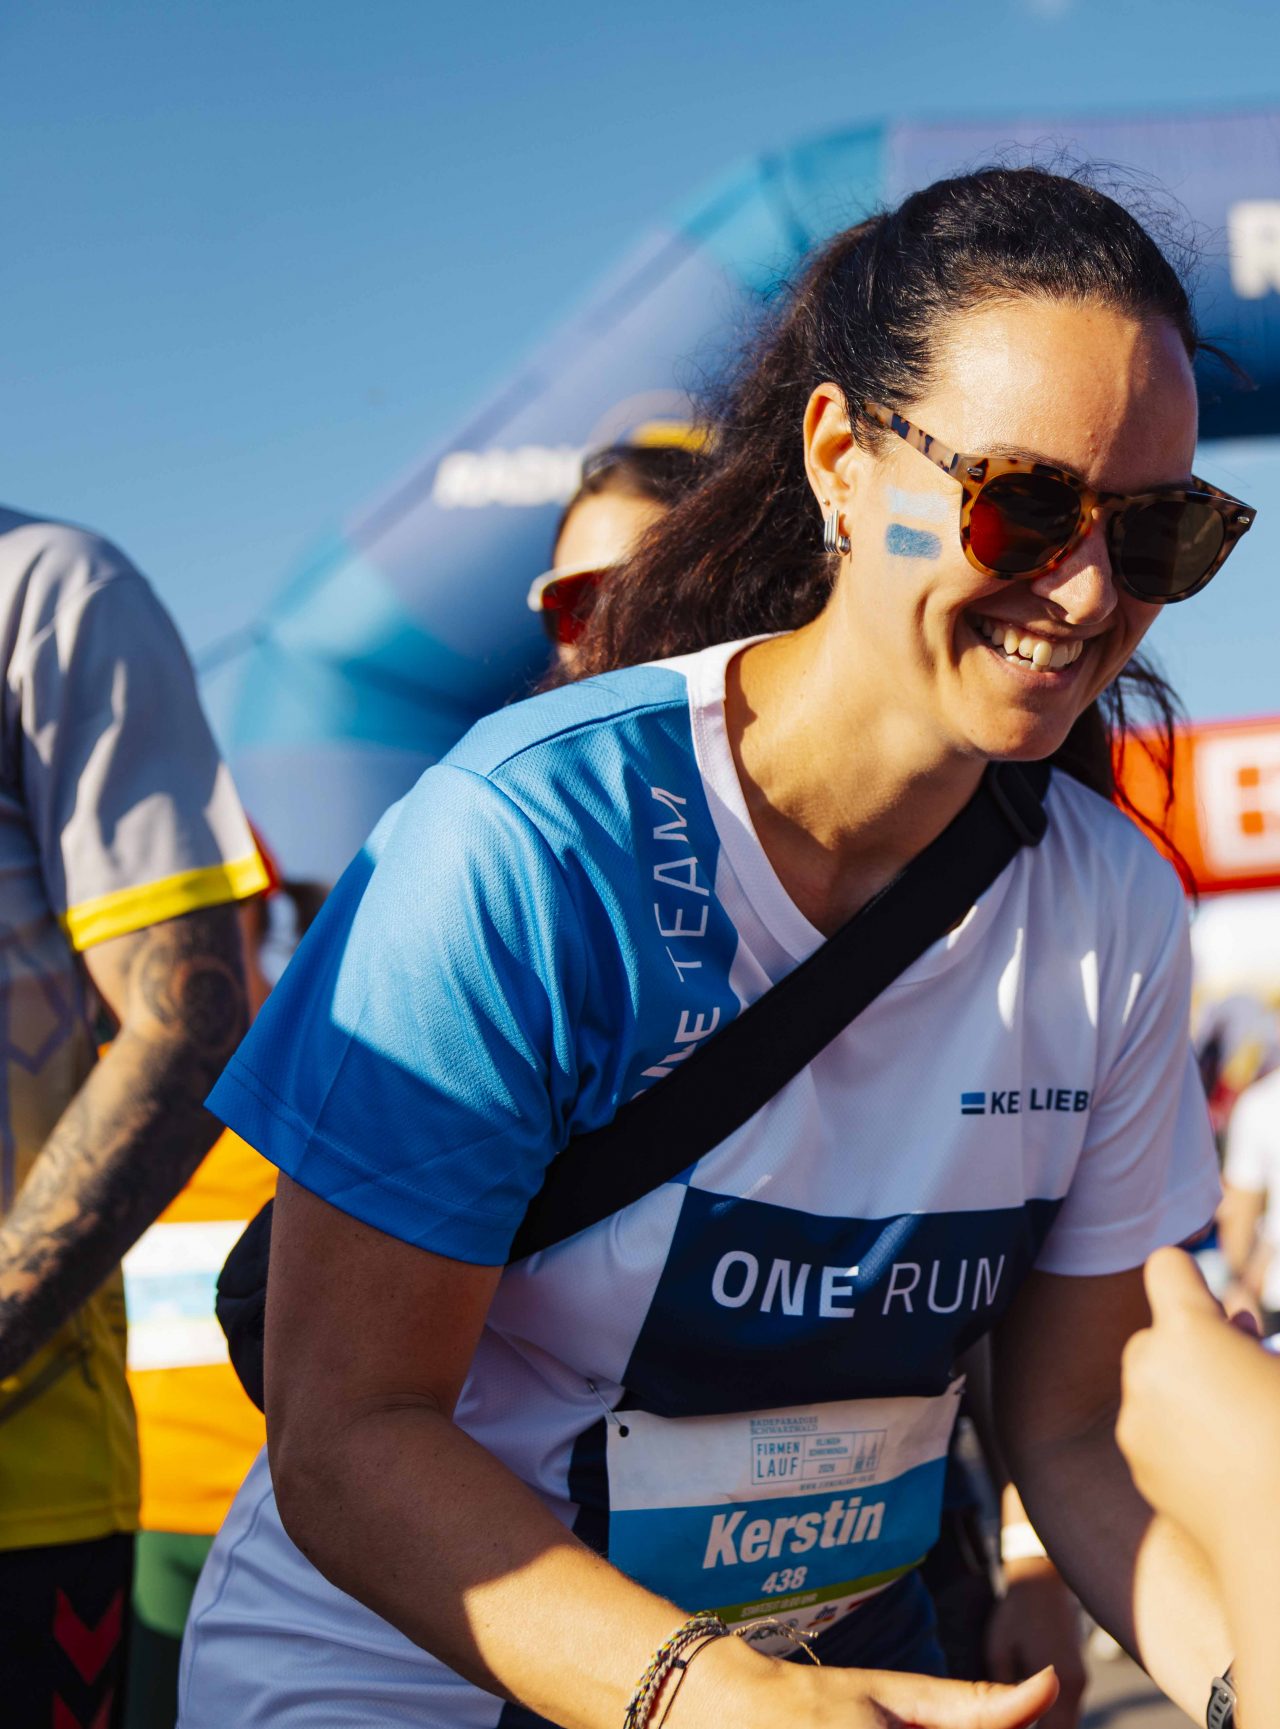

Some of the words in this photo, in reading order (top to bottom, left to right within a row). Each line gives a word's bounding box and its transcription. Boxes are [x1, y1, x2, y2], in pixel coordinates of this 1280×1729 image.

[651, 786, 710, 983] TEAM
[631, 1006, 721, 1101] NE
[710, 1250, 859, 1318] ONE
[882, 1254, 1006, 1316] RUN
[757, 1441, 800, 1455] FIRMEN
[757, 1457, 799, 1478] LAUF
[702, 1496, 886, 1569] Kerstin
[761, 1566, 808, 1593] 438
